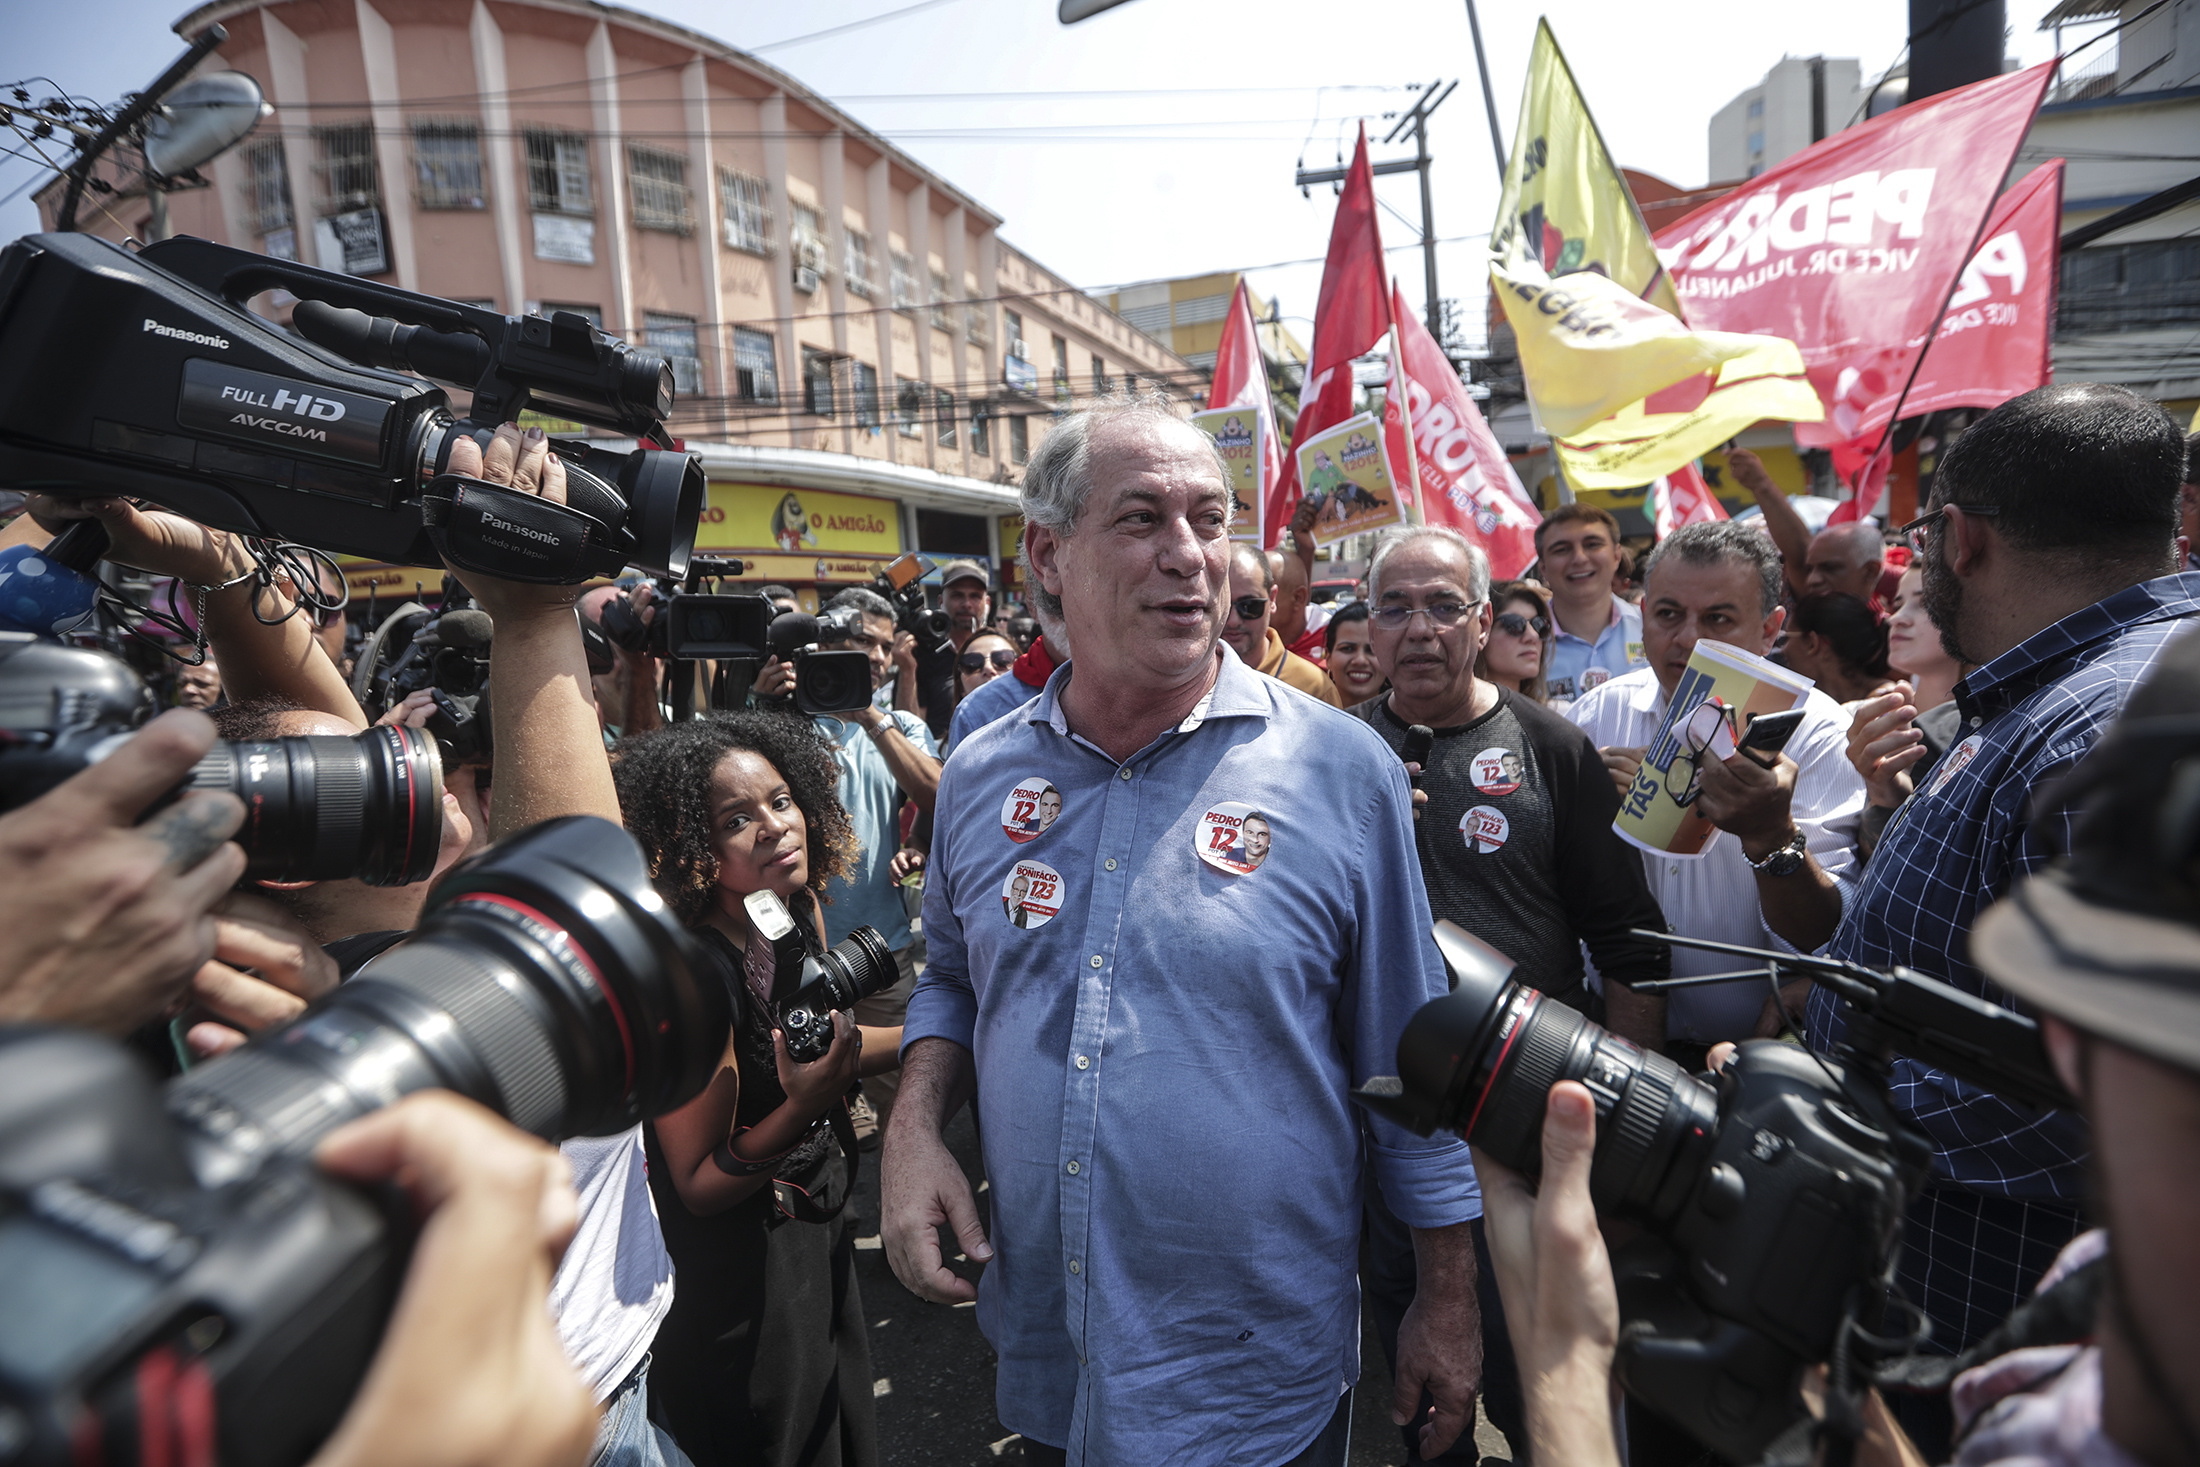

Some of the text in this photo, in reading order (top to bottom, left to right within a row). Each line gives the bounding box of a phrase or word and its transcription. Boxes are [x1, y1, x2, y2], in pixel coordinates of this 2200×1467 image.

[143, 318, 230, 350] Panasonic
[221, 386, 346, 422] FULL HD
[229, 413, 327, 442] AVCCAM
[1446, 486, 1480, 517] PDT
[480, 511, 560, 546] Panasonic
[810, 513, 886, 534] O AMIGÃO
[481, 534, 550, 561] Made in Japan
[1482, 766, 1502, 782] 12
[1012, 788, 1041, 801] PEDRO
[1012, 800, 1036, 824] 12
[1205, 811, 1243, 827] PEDRO
[1208, 826, 1238, 853] 12
[1481, 820, 1503, 835] 123
[1016, 866, 1058, 883] BONIFÁCIO
[1029, 880, 1057, 900] 123
